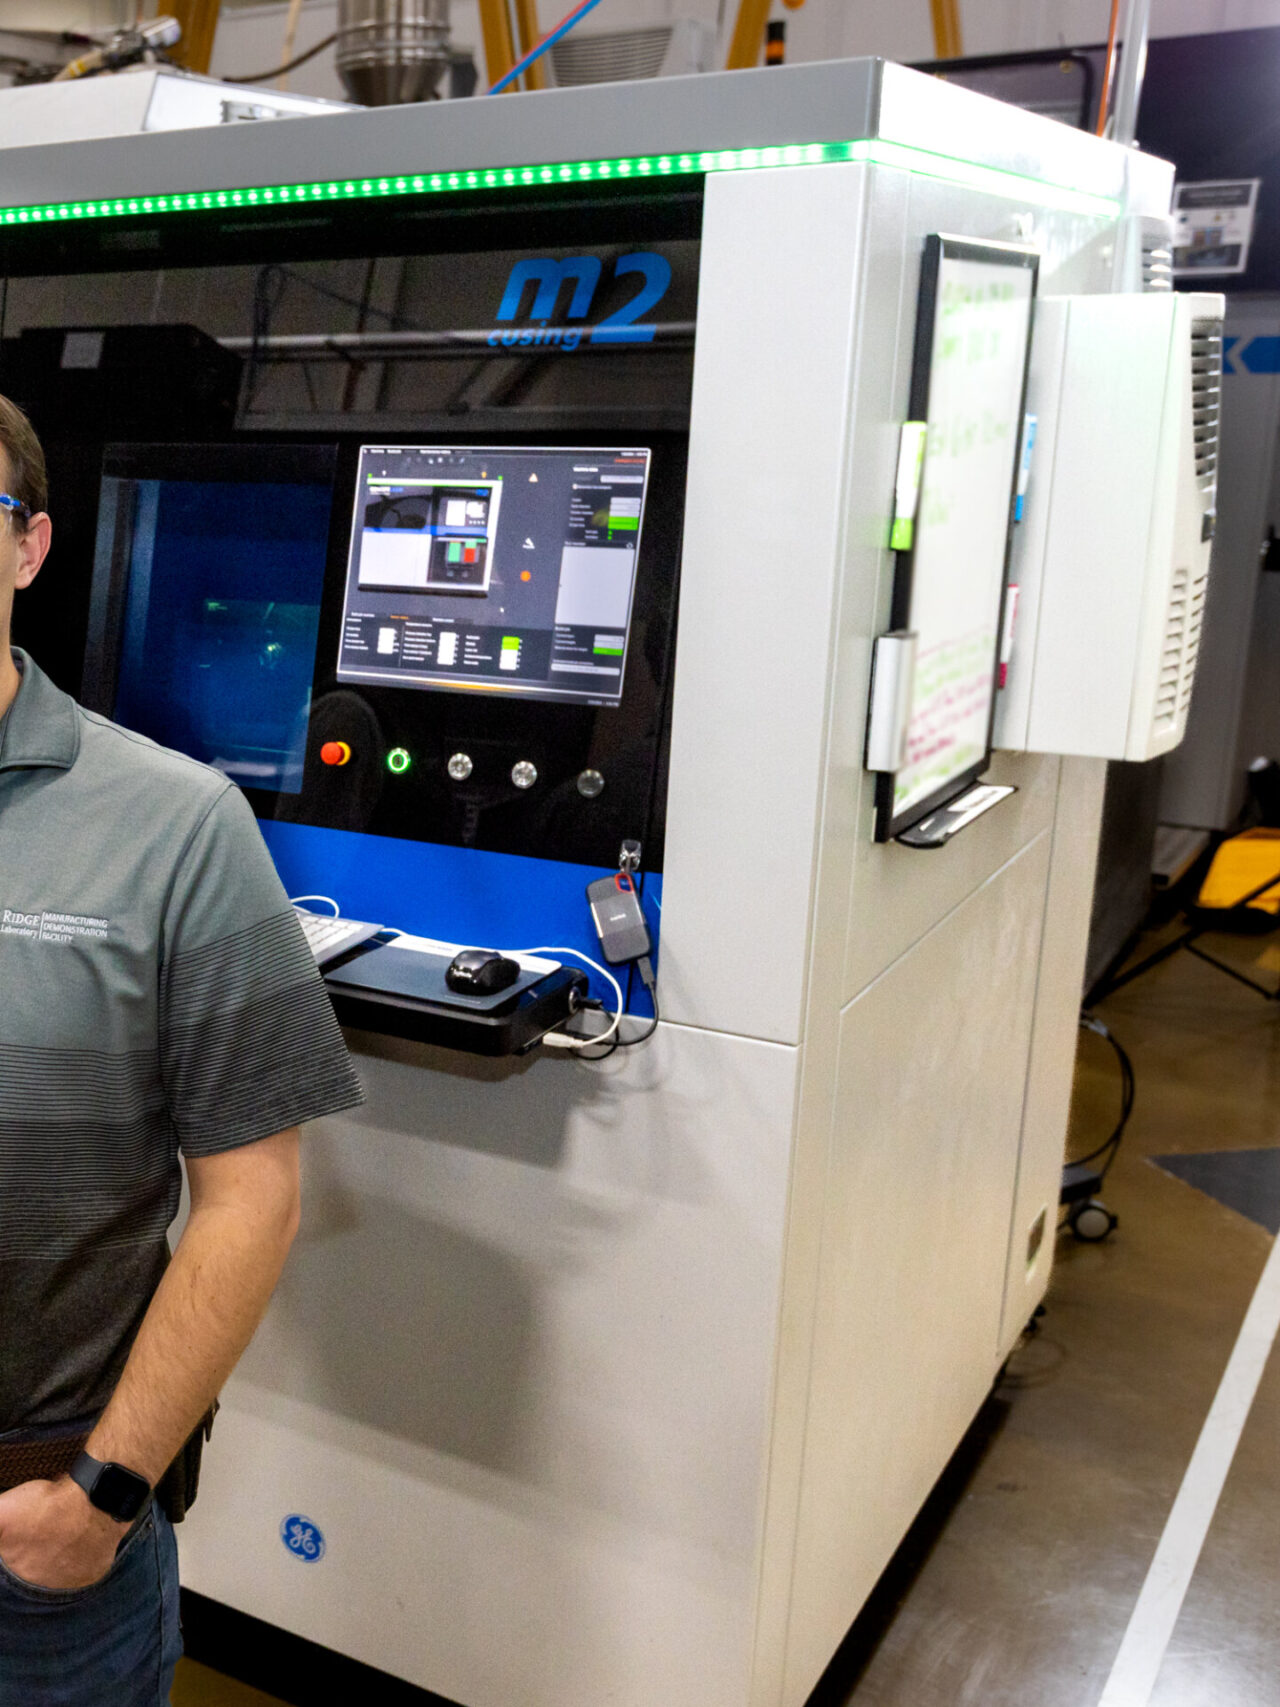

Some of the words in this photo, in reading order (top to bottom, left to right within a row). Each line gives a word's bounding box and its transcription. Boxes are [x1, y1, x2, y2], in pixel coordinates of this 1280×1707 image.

[496, 252, 672, 344] m2
[486, 320, 584, 352] cusing
[3, 909, 40, 926] RIDGE
[44, 912, 109, 928] MANUFACTURING
[0, 924, 38, 938] Laboratory
[42, 932, 73, 943] FACILITY
[43, 922, 108, 938] DEMONSTRATION
